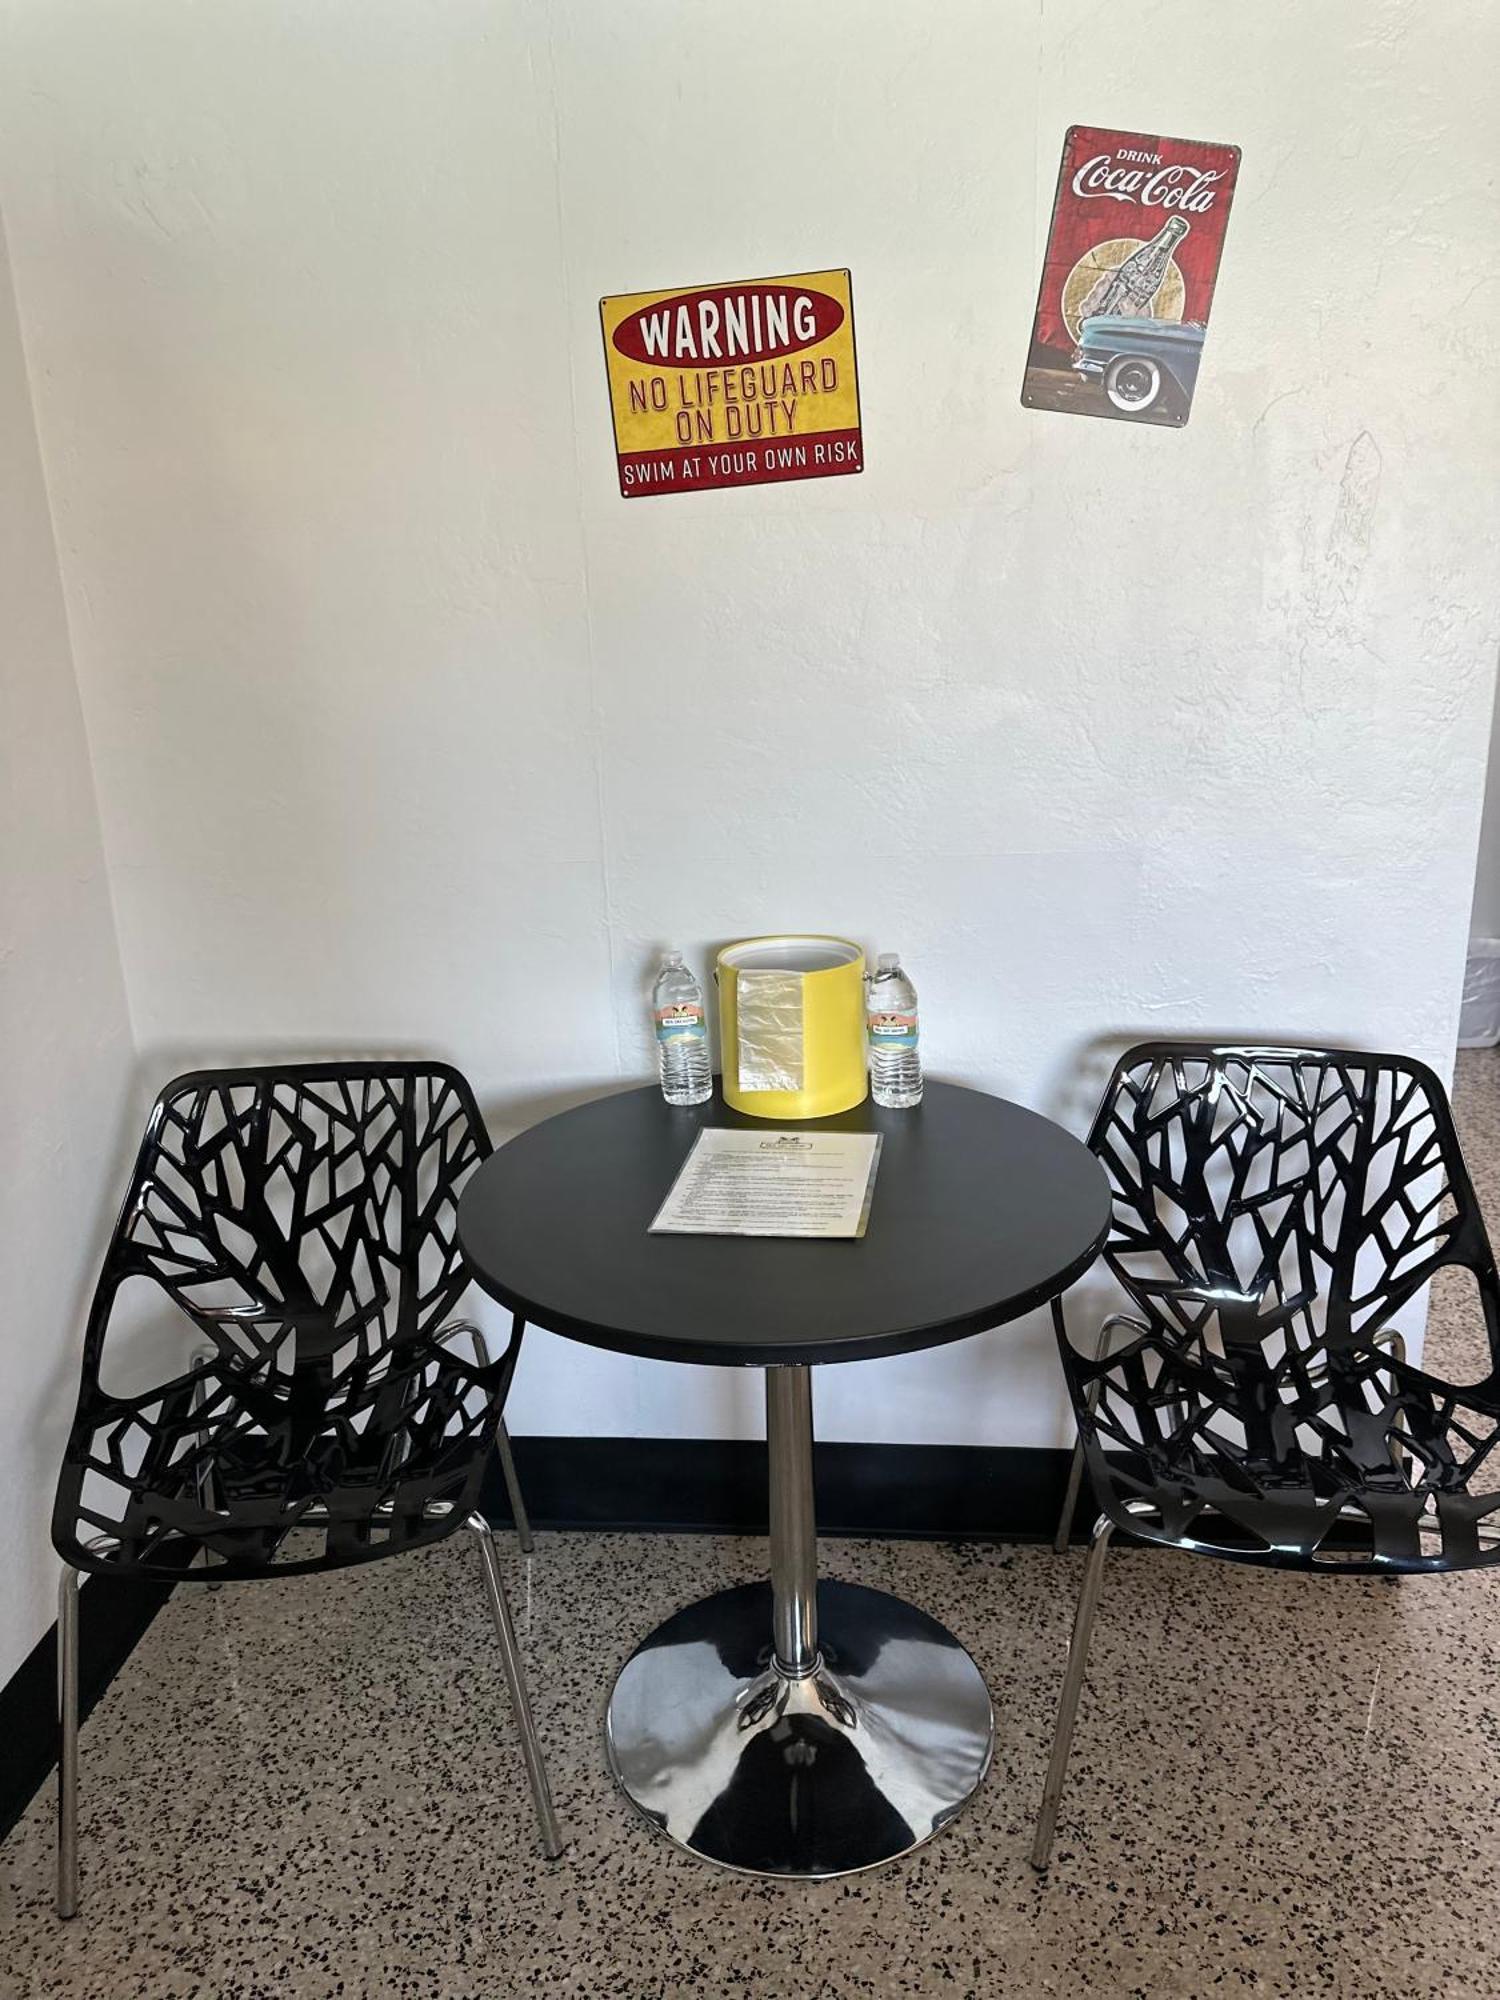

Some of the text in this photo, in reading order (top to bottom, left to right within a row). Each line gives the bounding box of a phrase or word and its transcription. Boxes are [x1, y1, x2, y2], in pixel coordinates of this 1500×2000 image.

[1116, 148, 1164, 166] DRINK
[639, 295, 817, 359] WARNING
[629, 358, 838, 412] NO LIFEGUARD
[675, 399, 798, 443] ON DUTY
[624, 440, 858, 485] SWIM AT YOUR OWN RISK
